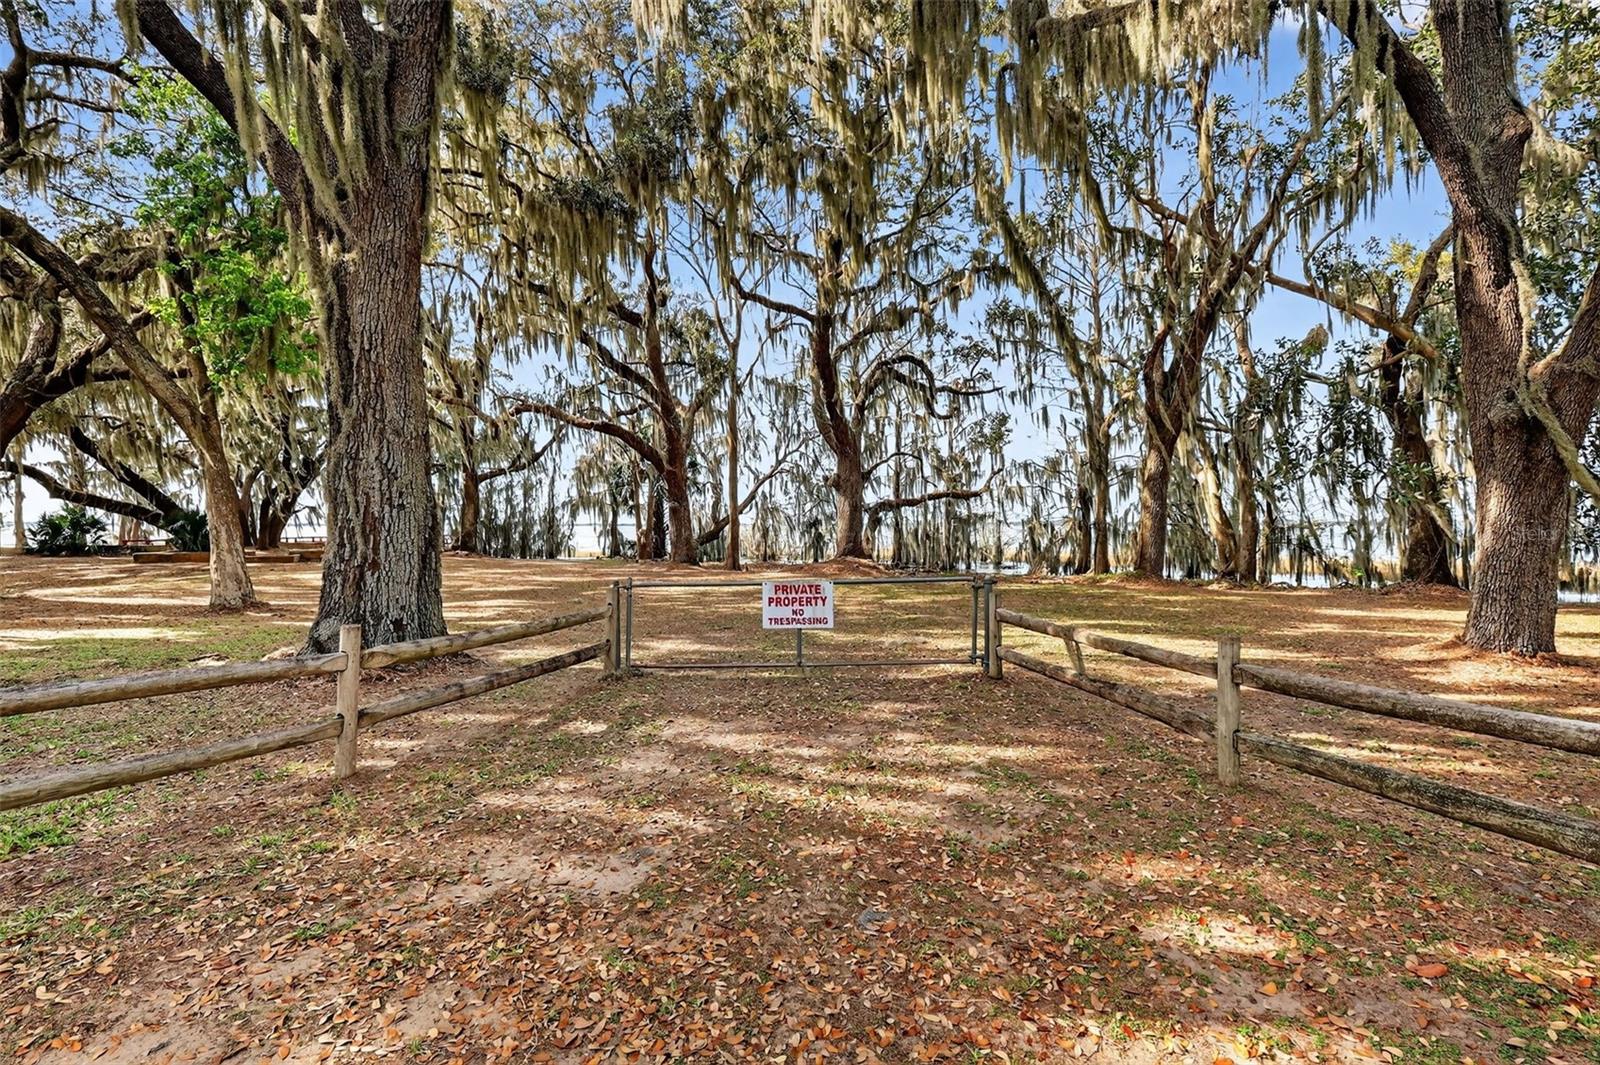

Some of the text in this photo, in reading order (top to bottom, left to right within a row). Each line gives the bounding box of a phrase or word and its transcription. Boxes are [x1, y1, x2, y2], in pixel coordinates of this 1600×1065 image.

[774, 584, 821, 595] PRIVATE
[768, 596, 827, 607] PROPERTY
[792, 608, 804, 616] NO
[768, 617, 828, 625] TRESPASSING
